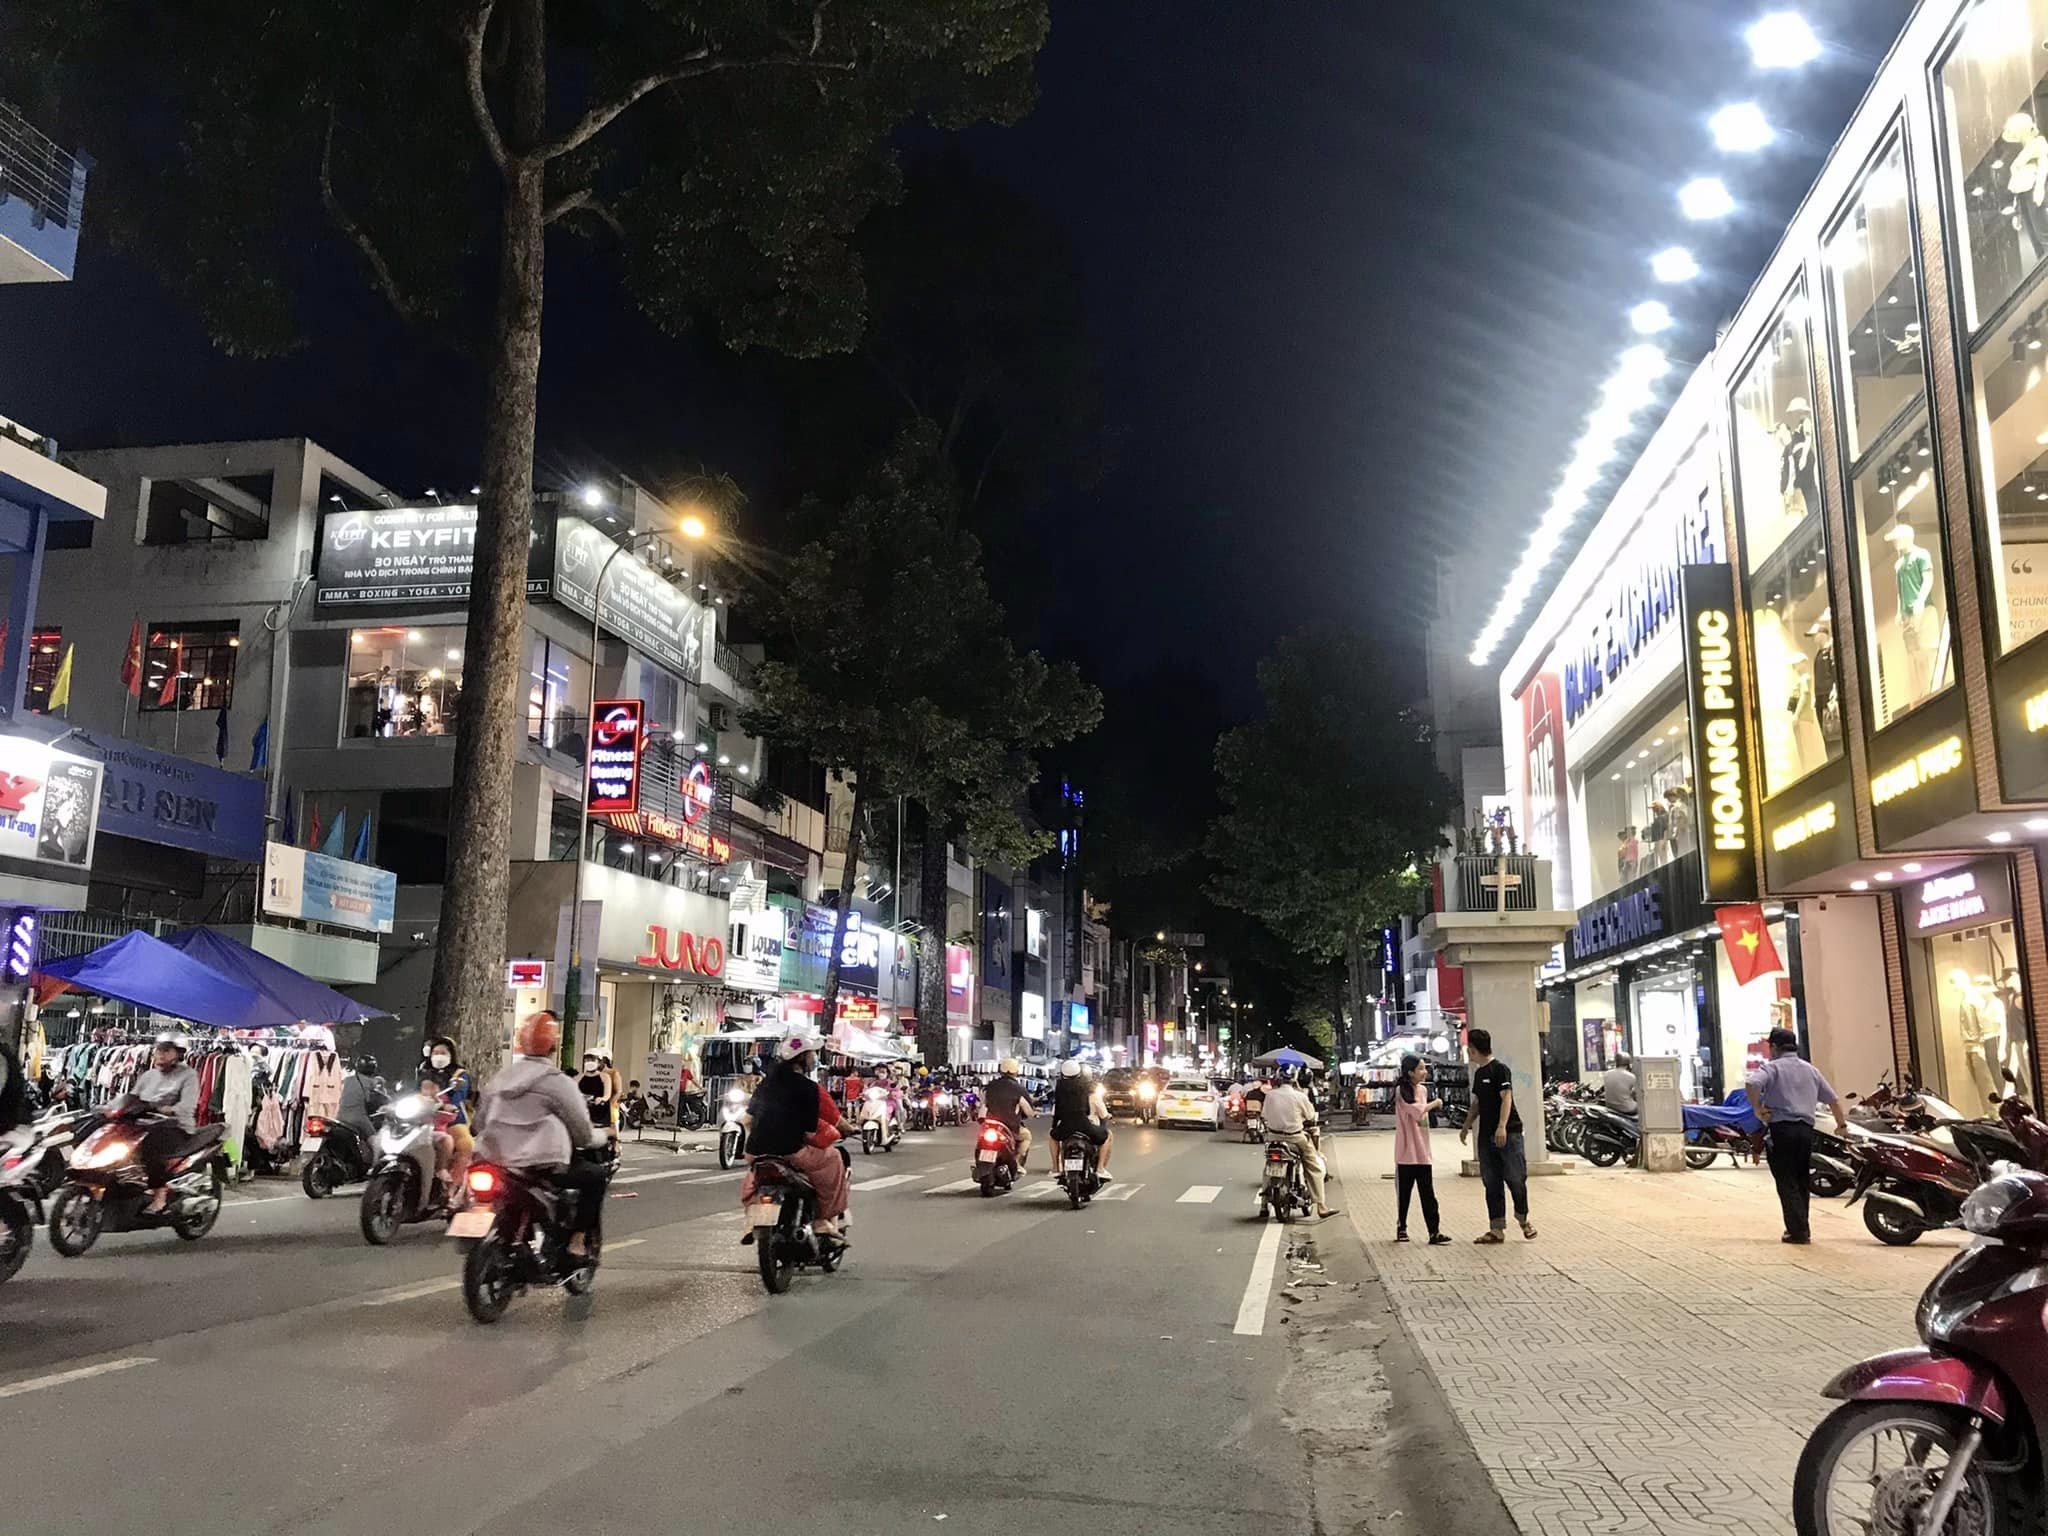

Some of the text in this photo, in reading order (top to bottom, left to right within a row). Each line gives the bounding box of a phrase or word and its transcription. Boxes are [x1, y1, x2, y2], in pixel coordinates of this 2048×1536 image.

[371, 527, 475, 549] KEYFIT
[375, 557, 391, 568] 30
[400, 565, 430, 576] TRONG
[325, 590, 349, 600] MMA
[359, 588, 398, 598] BOXING
[408, 586, 437, 597] YOGA
[1697, 609, 1736, 711] PHUC
[591, 749, 635, 763] Fitness
[596, 782, 627, 798] Yoga
[1706, 717, 1746, 851] HOANG
[8, 814, 37, 838] Trang
[1572, 908, 1599, 960] BLUE
[635, 924, 725, 977] JUNO
